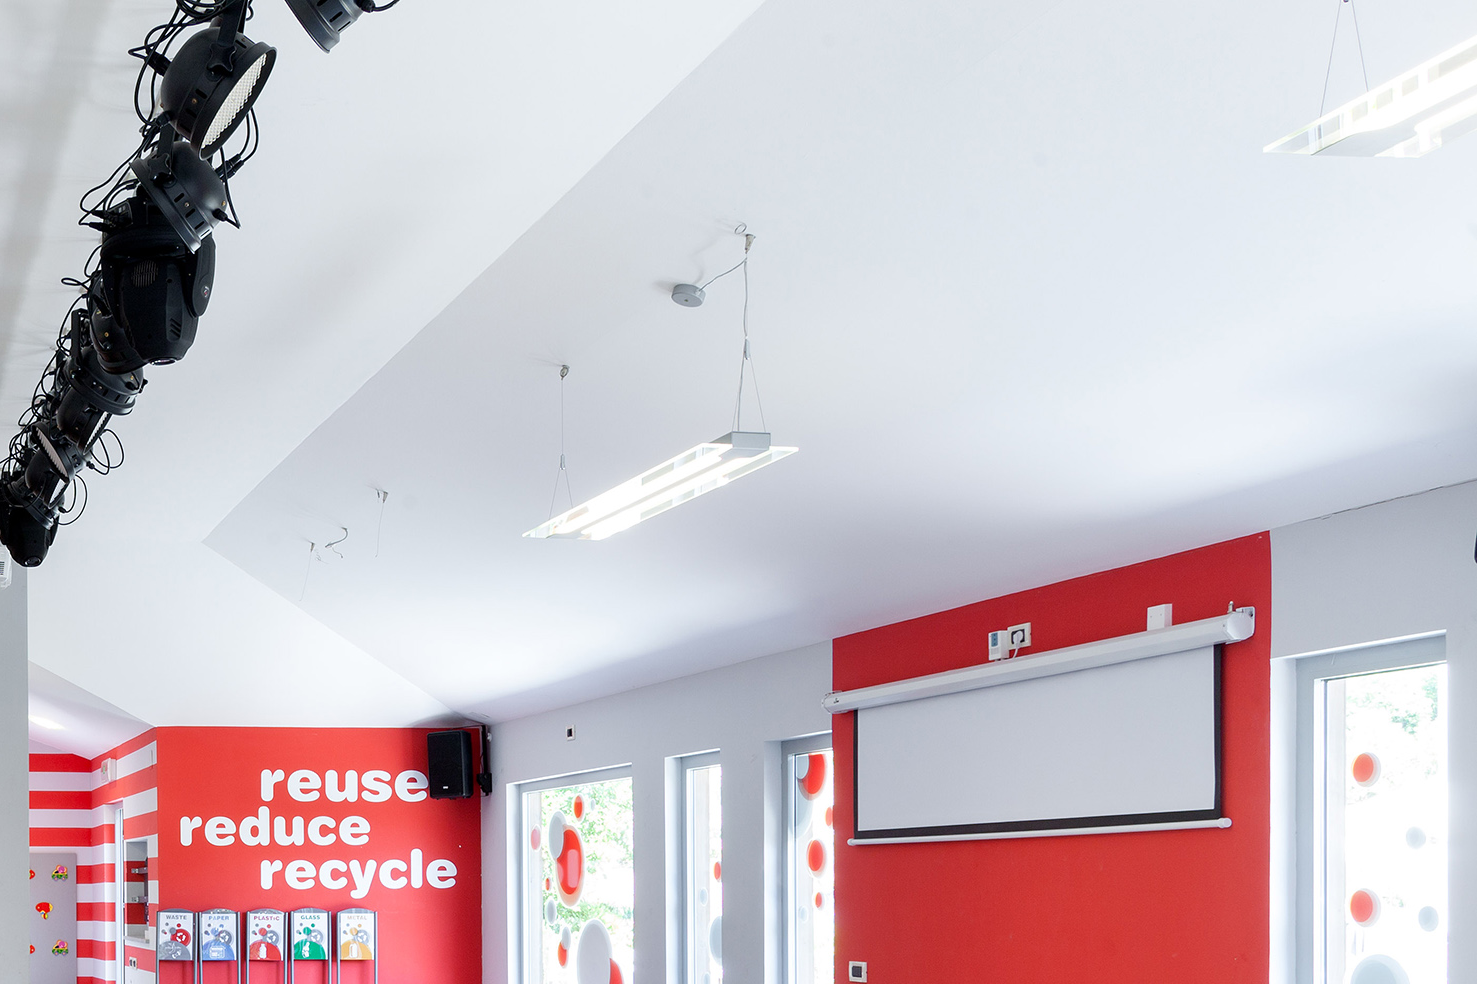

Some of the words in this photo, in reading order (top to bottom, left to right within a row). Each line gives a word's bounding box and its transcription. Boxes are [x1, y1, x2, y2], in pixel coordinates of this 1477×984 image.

[261, 769, 428, 802] reuse
[180, 806, 371, 846] reduce
[260, 848, 457, 899] recycle
